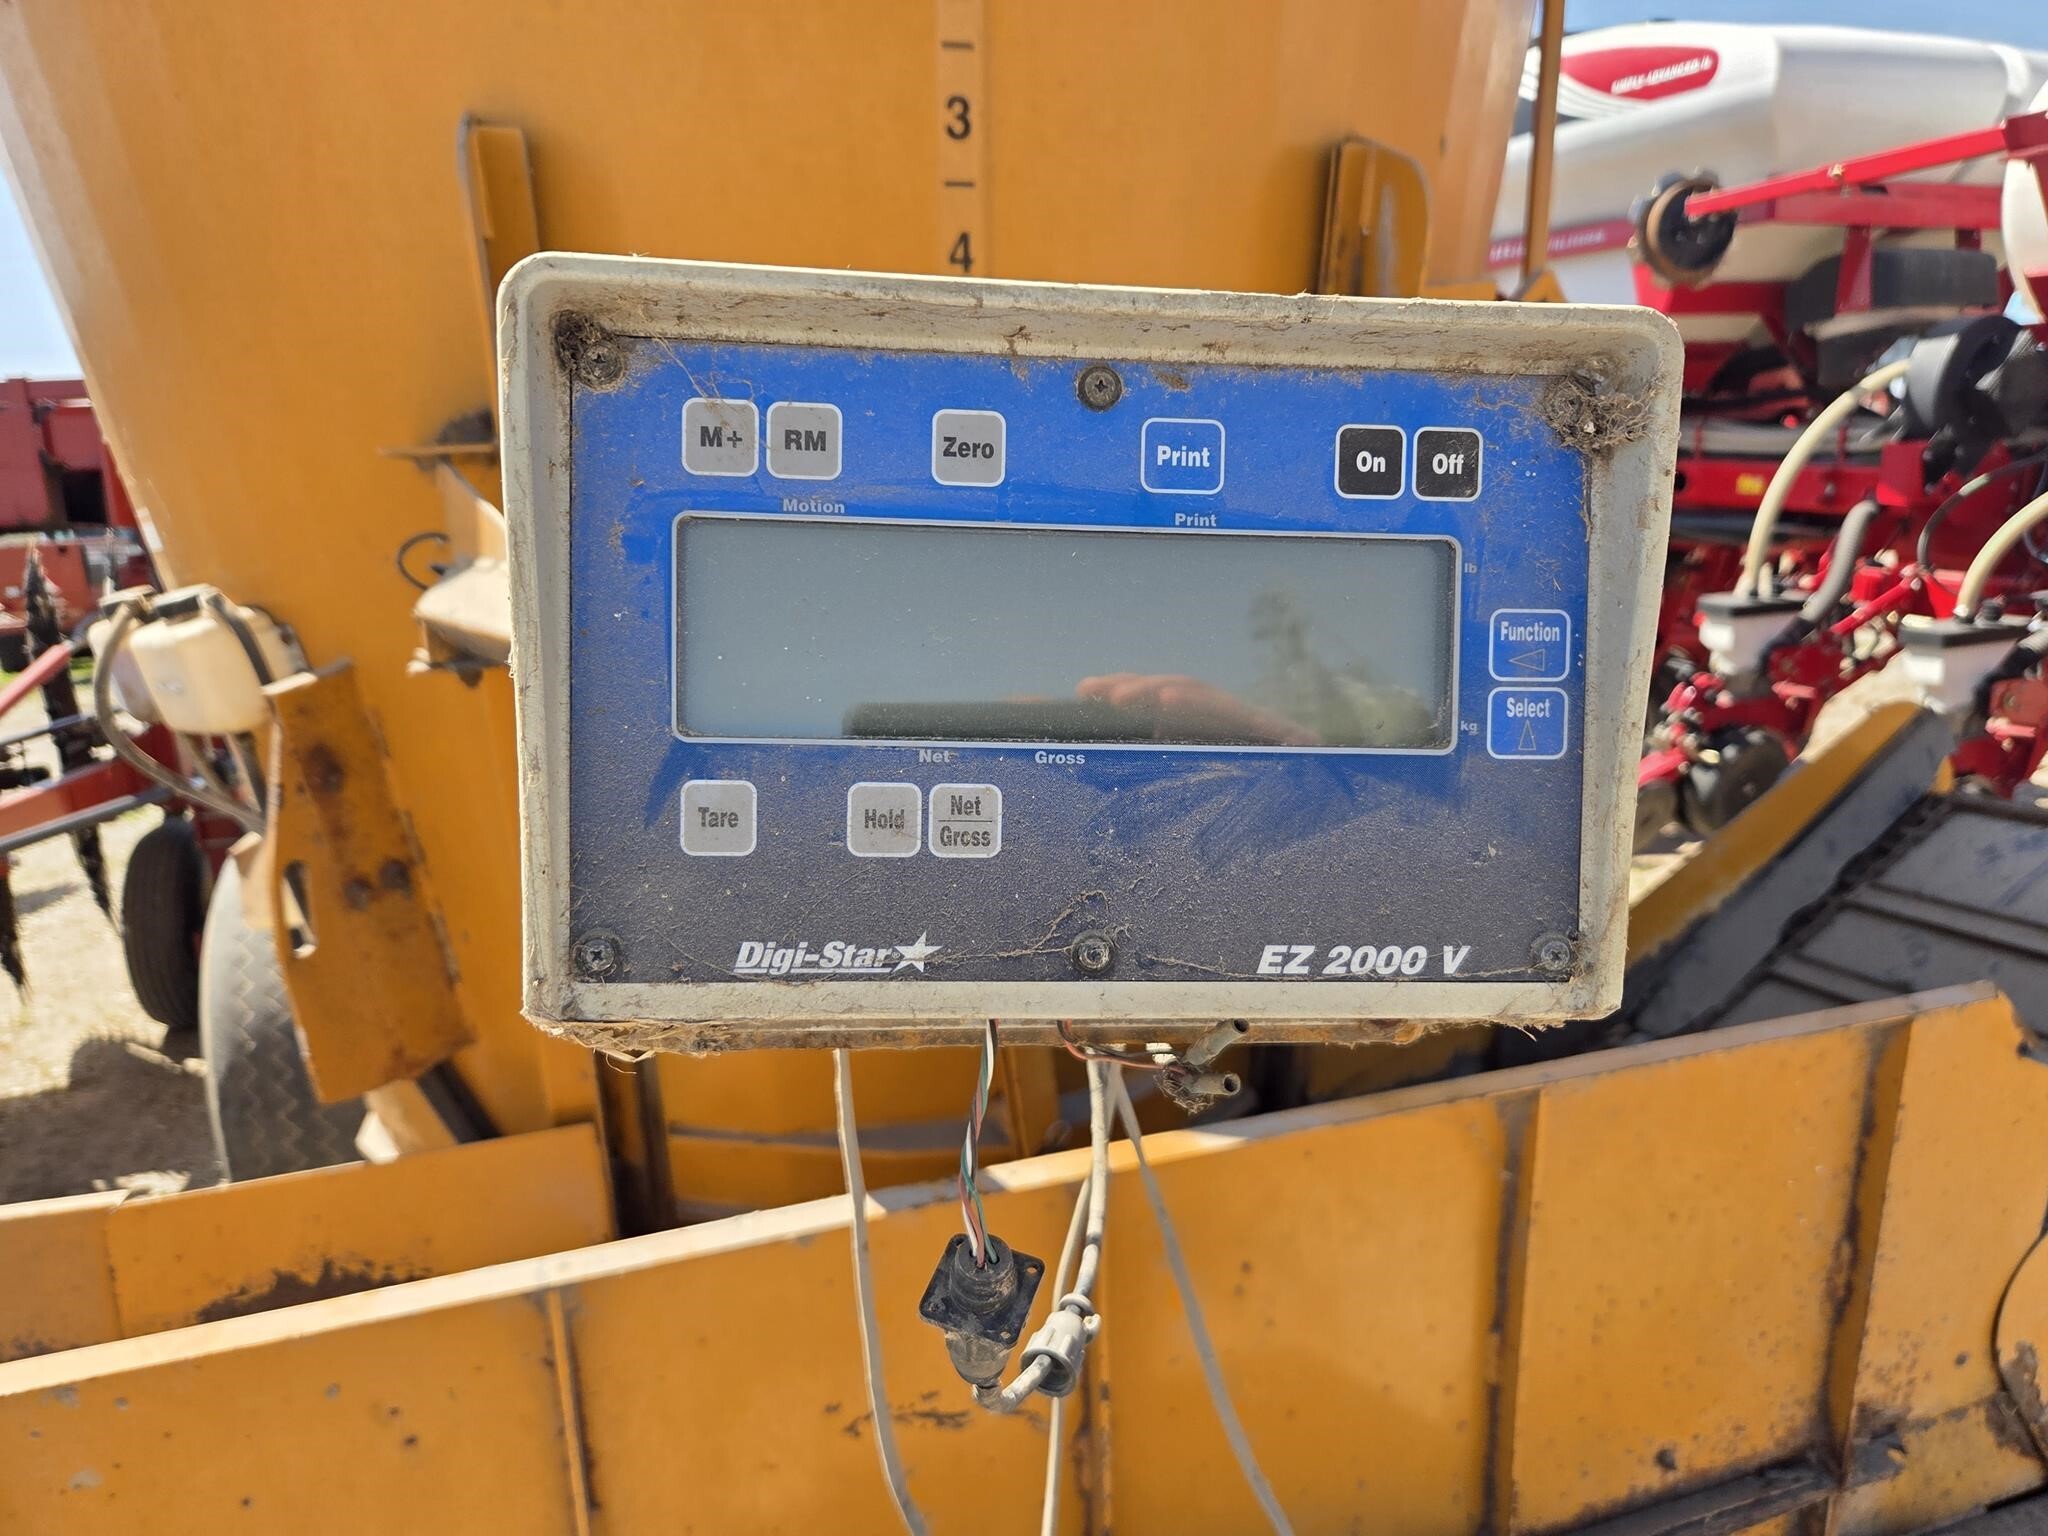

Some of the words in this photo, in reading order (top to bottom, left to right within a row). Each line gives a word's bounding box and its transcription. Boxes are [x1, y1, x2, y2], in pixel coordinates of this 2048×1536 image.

[945, 95, 972, 140] 3
[948, 231, 974, 273] 4
[700, 425, 743, 449] M+
[784, 429, 827, 452] RM
[942, 436, 995, 459] Zero
[1156, 445, 1211, 468] Print
[1355, 451, 1386, 473] On
[1432, 453, 1465, 475] Off
[782, 497, 845, 514] Motion
[1174, 512, 1217, 528] Print
[1464, 562, 1478, 574] lb
[1500, 621, 1561, 642] Function
[1506, 697, 1551, 718] Select
[1460, 720, 1478, 736] kg
[918, 749, 950, 763] Net
[1034, 751, 1086, 765] Gross
[949, 794, 982, 816] Net
[698, 806, 739, 829] Tare
[864, 808, 905, 830] Hold
[939, 825, 991, 848] Gross
[734, 940, 892, 975] Digi-Star
[1256, 944, 1316, 975] EZ
[1322, 945, 1428, 975] 2000
[1442, 945, 1471, 975] V
